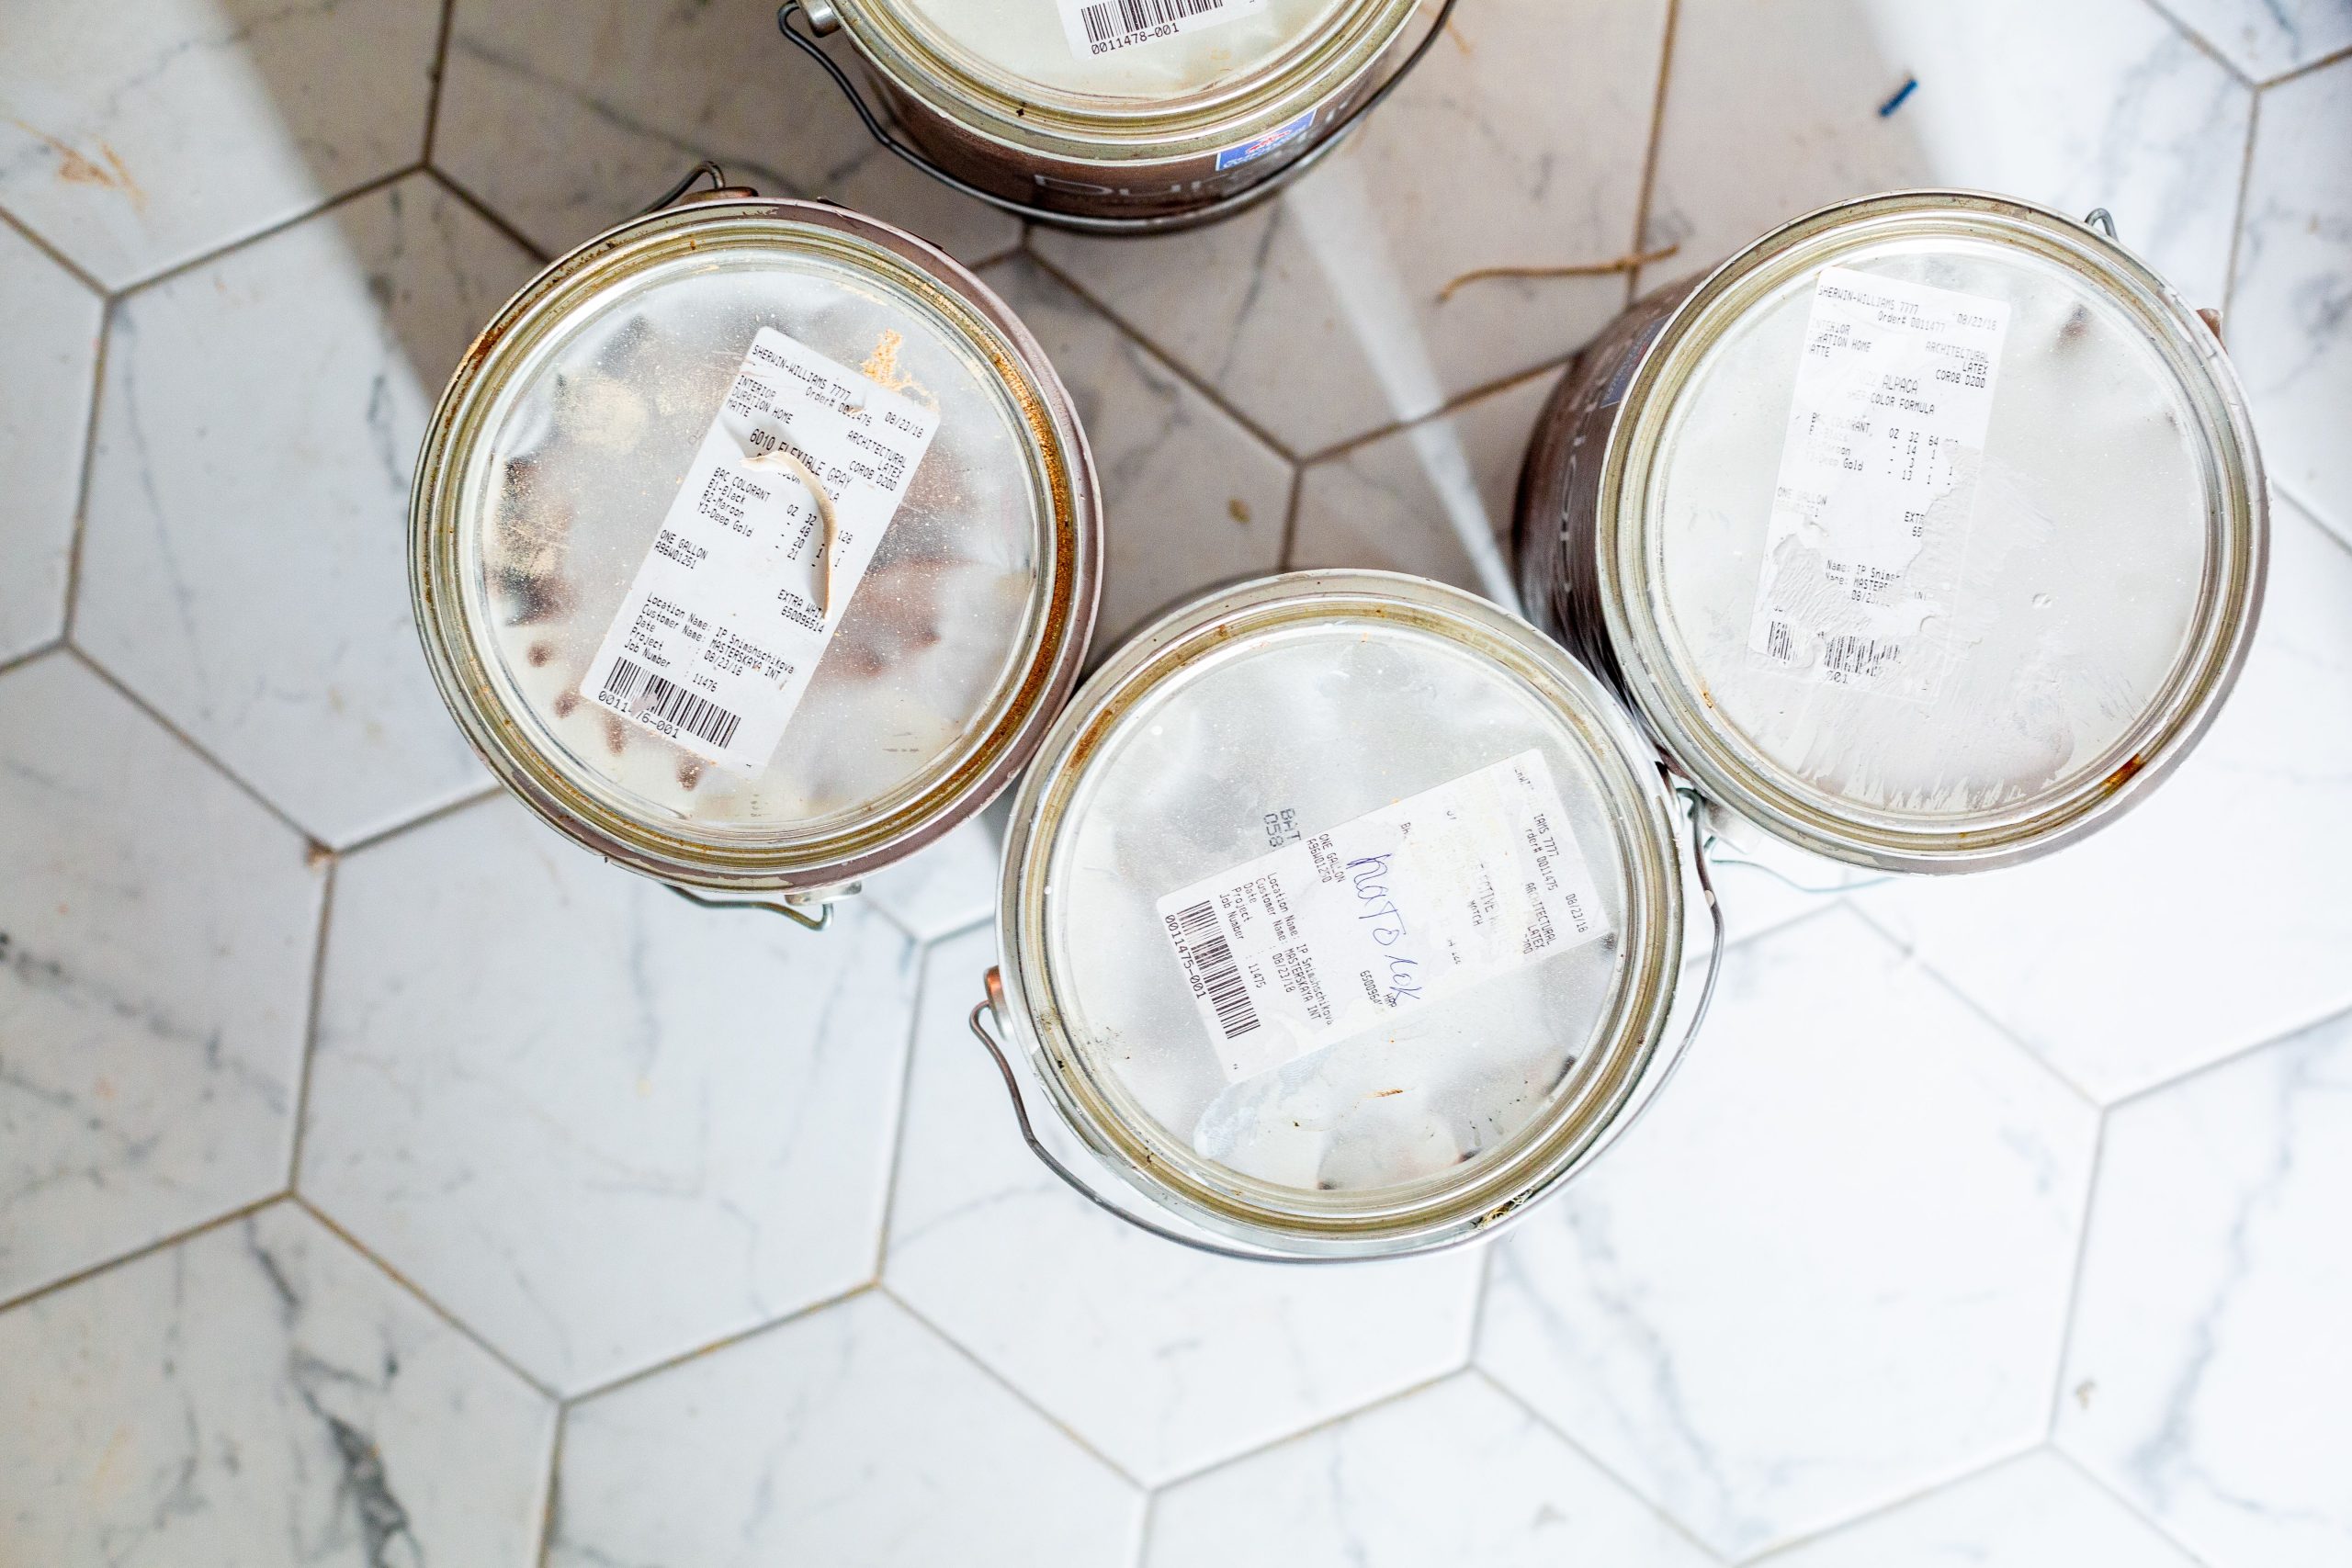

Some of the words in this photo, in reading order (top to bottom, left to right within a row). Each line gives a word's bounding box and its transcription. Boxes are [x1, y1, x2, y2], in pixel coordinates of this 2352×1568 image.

[1090, 19, 1180, 57] 0011478-001
[1817, 284, 1895, 310] SHERWIN-WILLIAMS
[1898, 300, 1919, 315] 7777
[1876, 310, 1907, 326] Order#
[1808, 343, 1830, 357] ATTE
[1964, 374, 1986, 389] D200
[1815, 331, 1848, 348] RATION
[1850, 338, 1871, 353] HOME
[1962, 360, 1988, 377] LATEX
[1924, 340, 1991, 364] ARCHITECTURAL
[751, 344, 829, 389] SHERWIN-WILLIAMS
[828, 383, 852, 401] 7777
[883, 410, 925, 438] 08/23/18
[804, 385, 837, 409] Order#
[836, 400, 873, 427] 00476
[1881, 373, 1919, 395] ALPACA
[1898, 397, 1936, 415] FORMULA
[724, 397, 752, 418] MATTE
[847, 459, 876, 480] COROB
[875, 473, 898, 492] D200
[730, 386, 772, 413] DURATION
[771, 406, 794, 424] HOME
[876, 459, 903, 480] LATEX
[736, 374, 777, 401] INTERIOR
[845, 429, 910, 468] ARCHITECTURAL
[1908, 430, 1919, 444] 32
[1927, 434, 1939, 447] 64
[748, 427, 777, 452] 6010
[824, 466, 854, 491] GRAY
[1842, 457, 1864, 471] Gold
[1901, 468, 1913, 481] 13
[1905, 444, 1917, 457] 14
[706, 478, 747, 505] B1-Black
[712, 466, 730, 483] BAC
[729, 475, 772, 503] COLORANT
[804, 512, 818, 526] 32
[695, 501, 731, 527] Y3-Deep
[730, 519, 754, 538] Gold
[786, 547, 799, 561] 21
[700, 489, 747, 519] R2-Maroon
[792, 536, 806, 550] 20
[815, 547, 824, 558] 1
[652, 540, 697, 570] A96W01251
[779, 604, 826, 635] 650096514
[658, 528, 677, 545] ONE
[676, 537, 708, 560] GALLON
[776, 588, 805, 610] EXTRA
[803, 602, 828, 622] WHI
[628, 626, 665, 652] Project
[639, 603, 681, 630] Customer
[680, 624, 707, 645] Name:
[707, 637, 763, 672] MASTERSKAYA
[763, 665, 781, 682] INT
[645, 592, 687, 620] Location
[685, 612, 713, 633] Name:
[714, 626, 728, 640] IP
[623, 637, 641, 654] Job
[640, 647, 673, 670] Number
[691, 672, 718, 694] 11476
[634, 614, 658, 633] Date
[702, 649, 744, 677] 08/23/18
[595, 689, 682, 739] 001176-001
[1317, 832, 1333, 851] ONE
[1523, 826, 1543, 854] rder#
[1535, 854, 1559, 892] 0011475
[1229, 886, 1253, 923] Project
[1541, 835, 1559, 859] 7777
[1564, 892, 1589, 933] 08/23/18
[1218, 891, 1233, 909] Job
[1226, 909, 1246, 942] Number
[1247, 962, 1266, 989] 11475
[1242, 881, 1260, 904] Date
[1271, 952, 1295, 994] 08/23/18
[1266, 871, 1291, 913] Location
[1283, 913, 1302, 941] Name:
[1295, 942, 1308, 955] IP
[1526, 922, 1545, 950] LATEX
[1163, 912, 1207, 1000] 0011475-001
[1254, 875, 1279, 917] Customer
[1283, 947, 1314, 1003] MASTERSKAYA
[1306, 1004, 1321, 1021] INT
